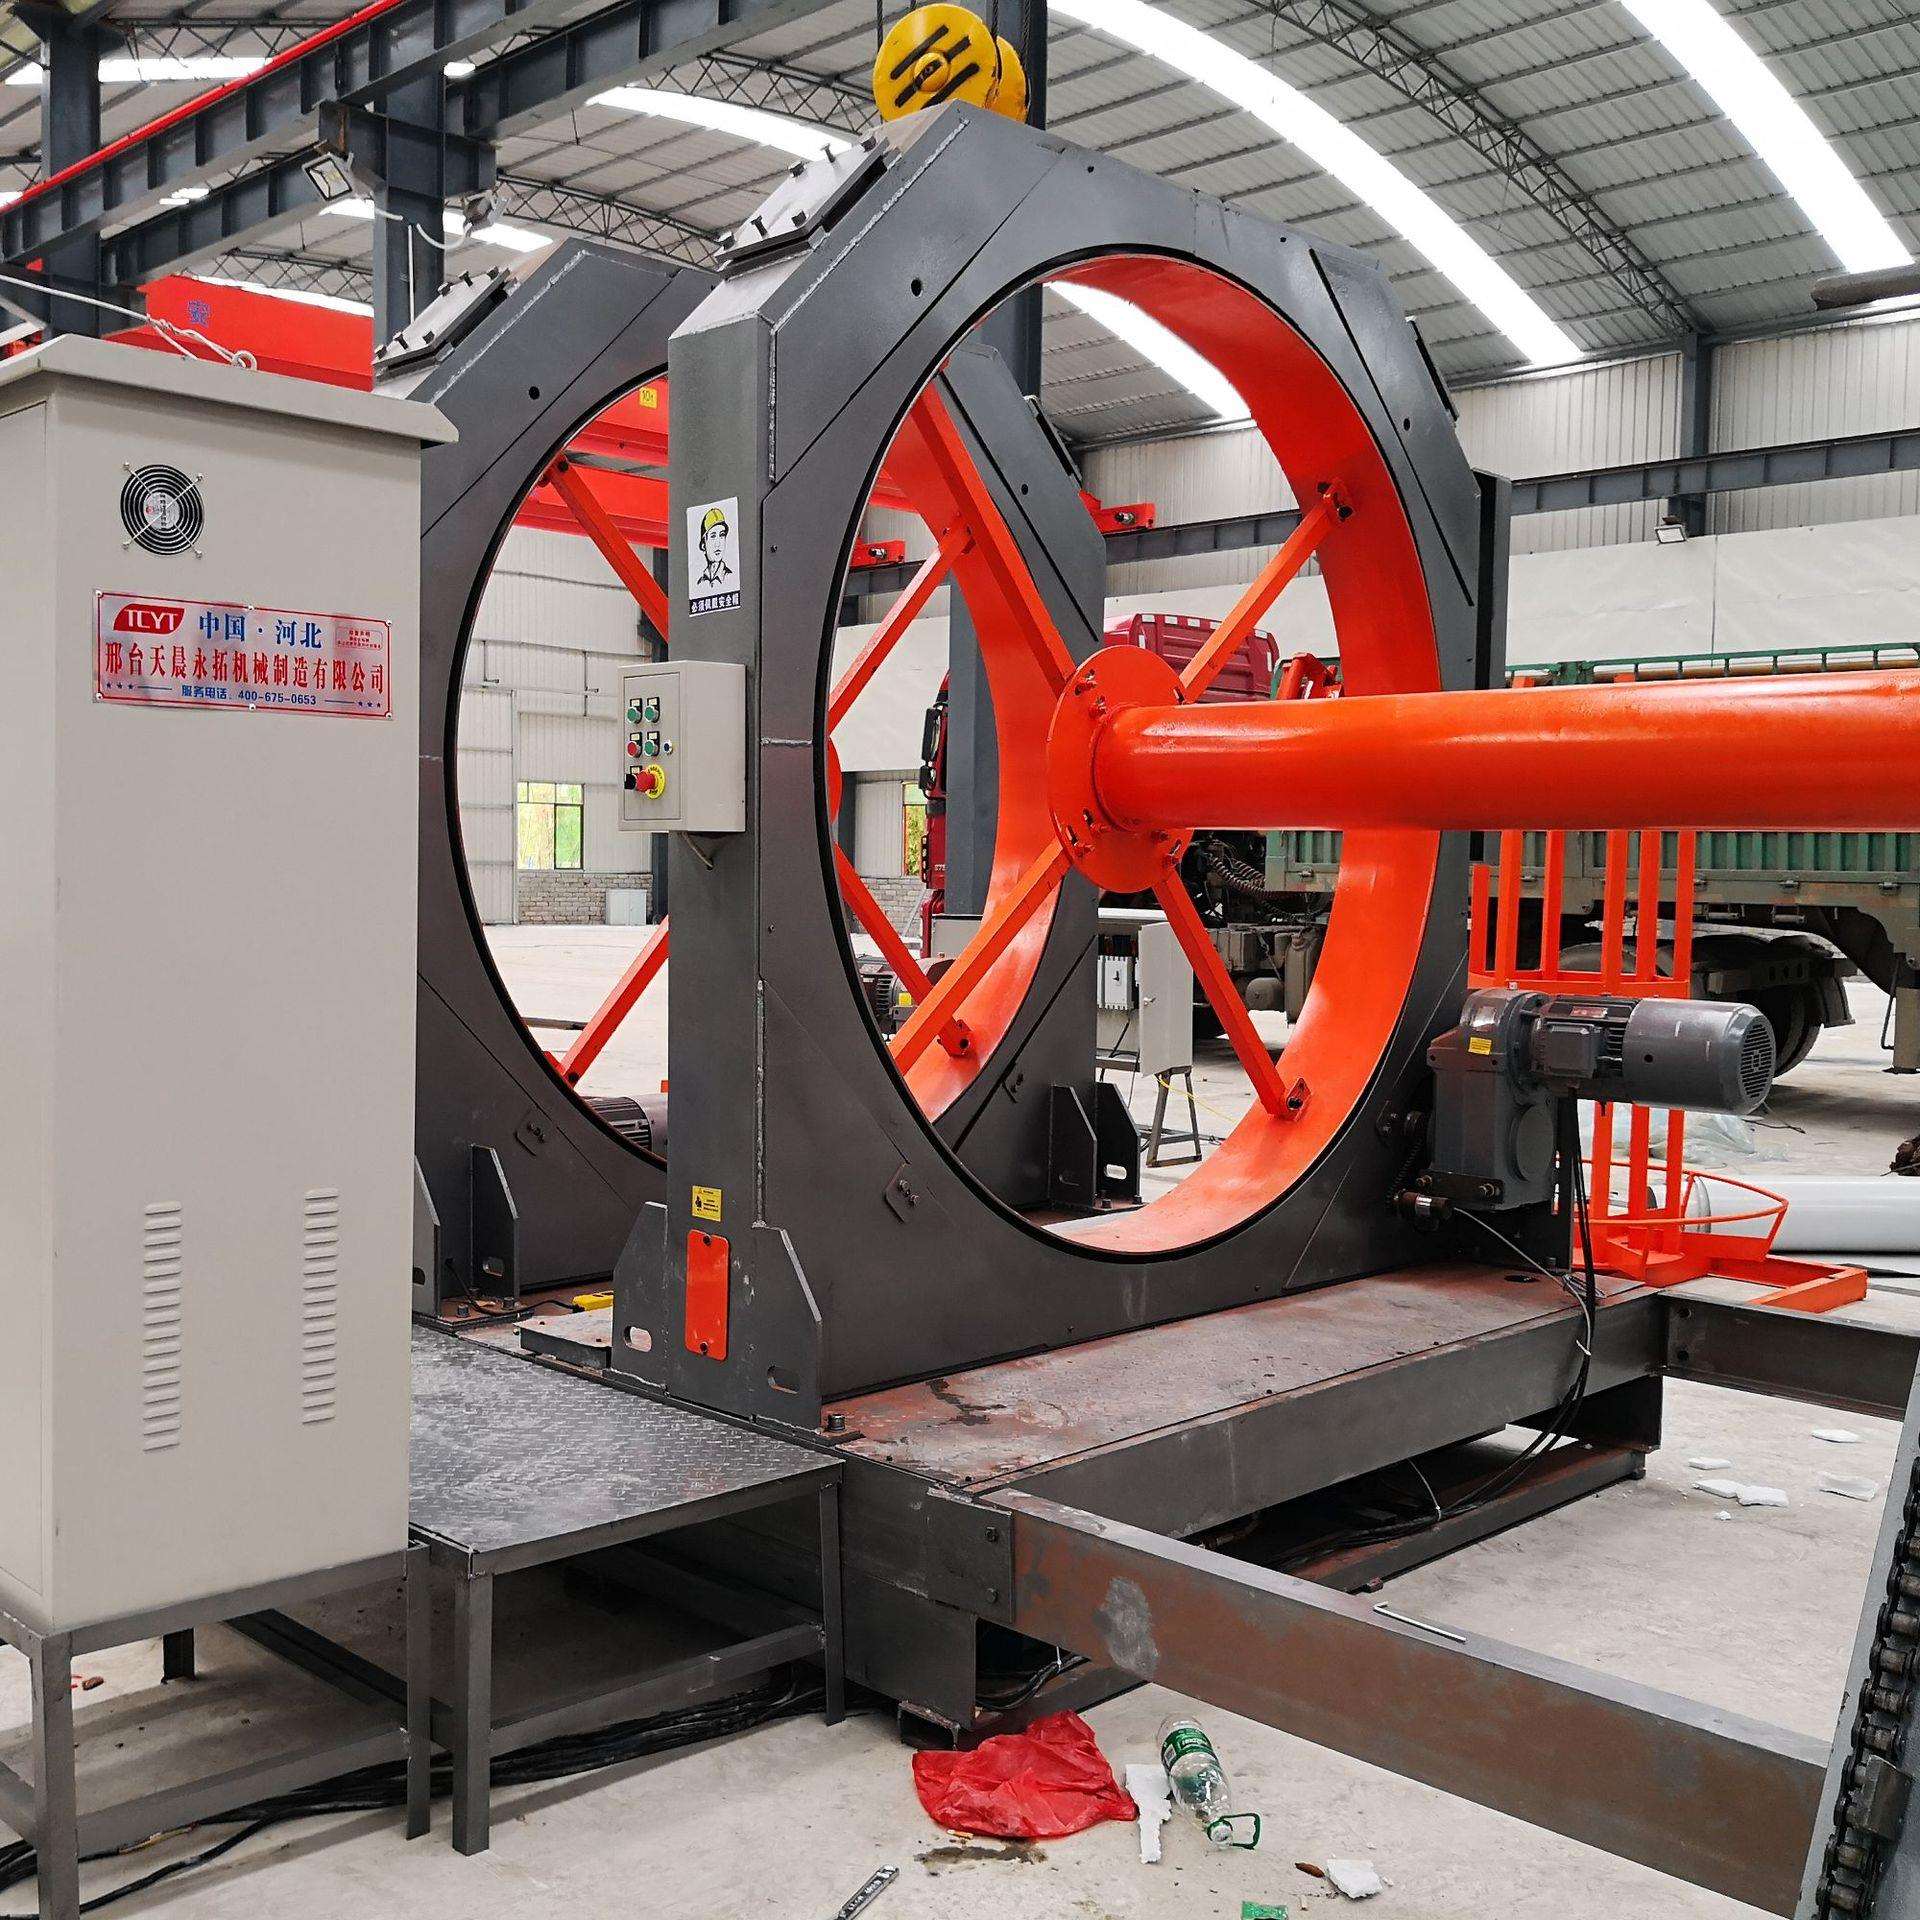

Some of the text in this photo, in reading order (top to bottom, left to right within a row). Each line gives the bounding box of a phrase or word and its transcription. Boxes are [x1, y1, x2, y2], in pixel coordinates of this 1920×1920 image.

[125, 608, 180, 632] TCYT
[105, 641, 384, 695] 邢台天晨永拓机械制造有限公司
